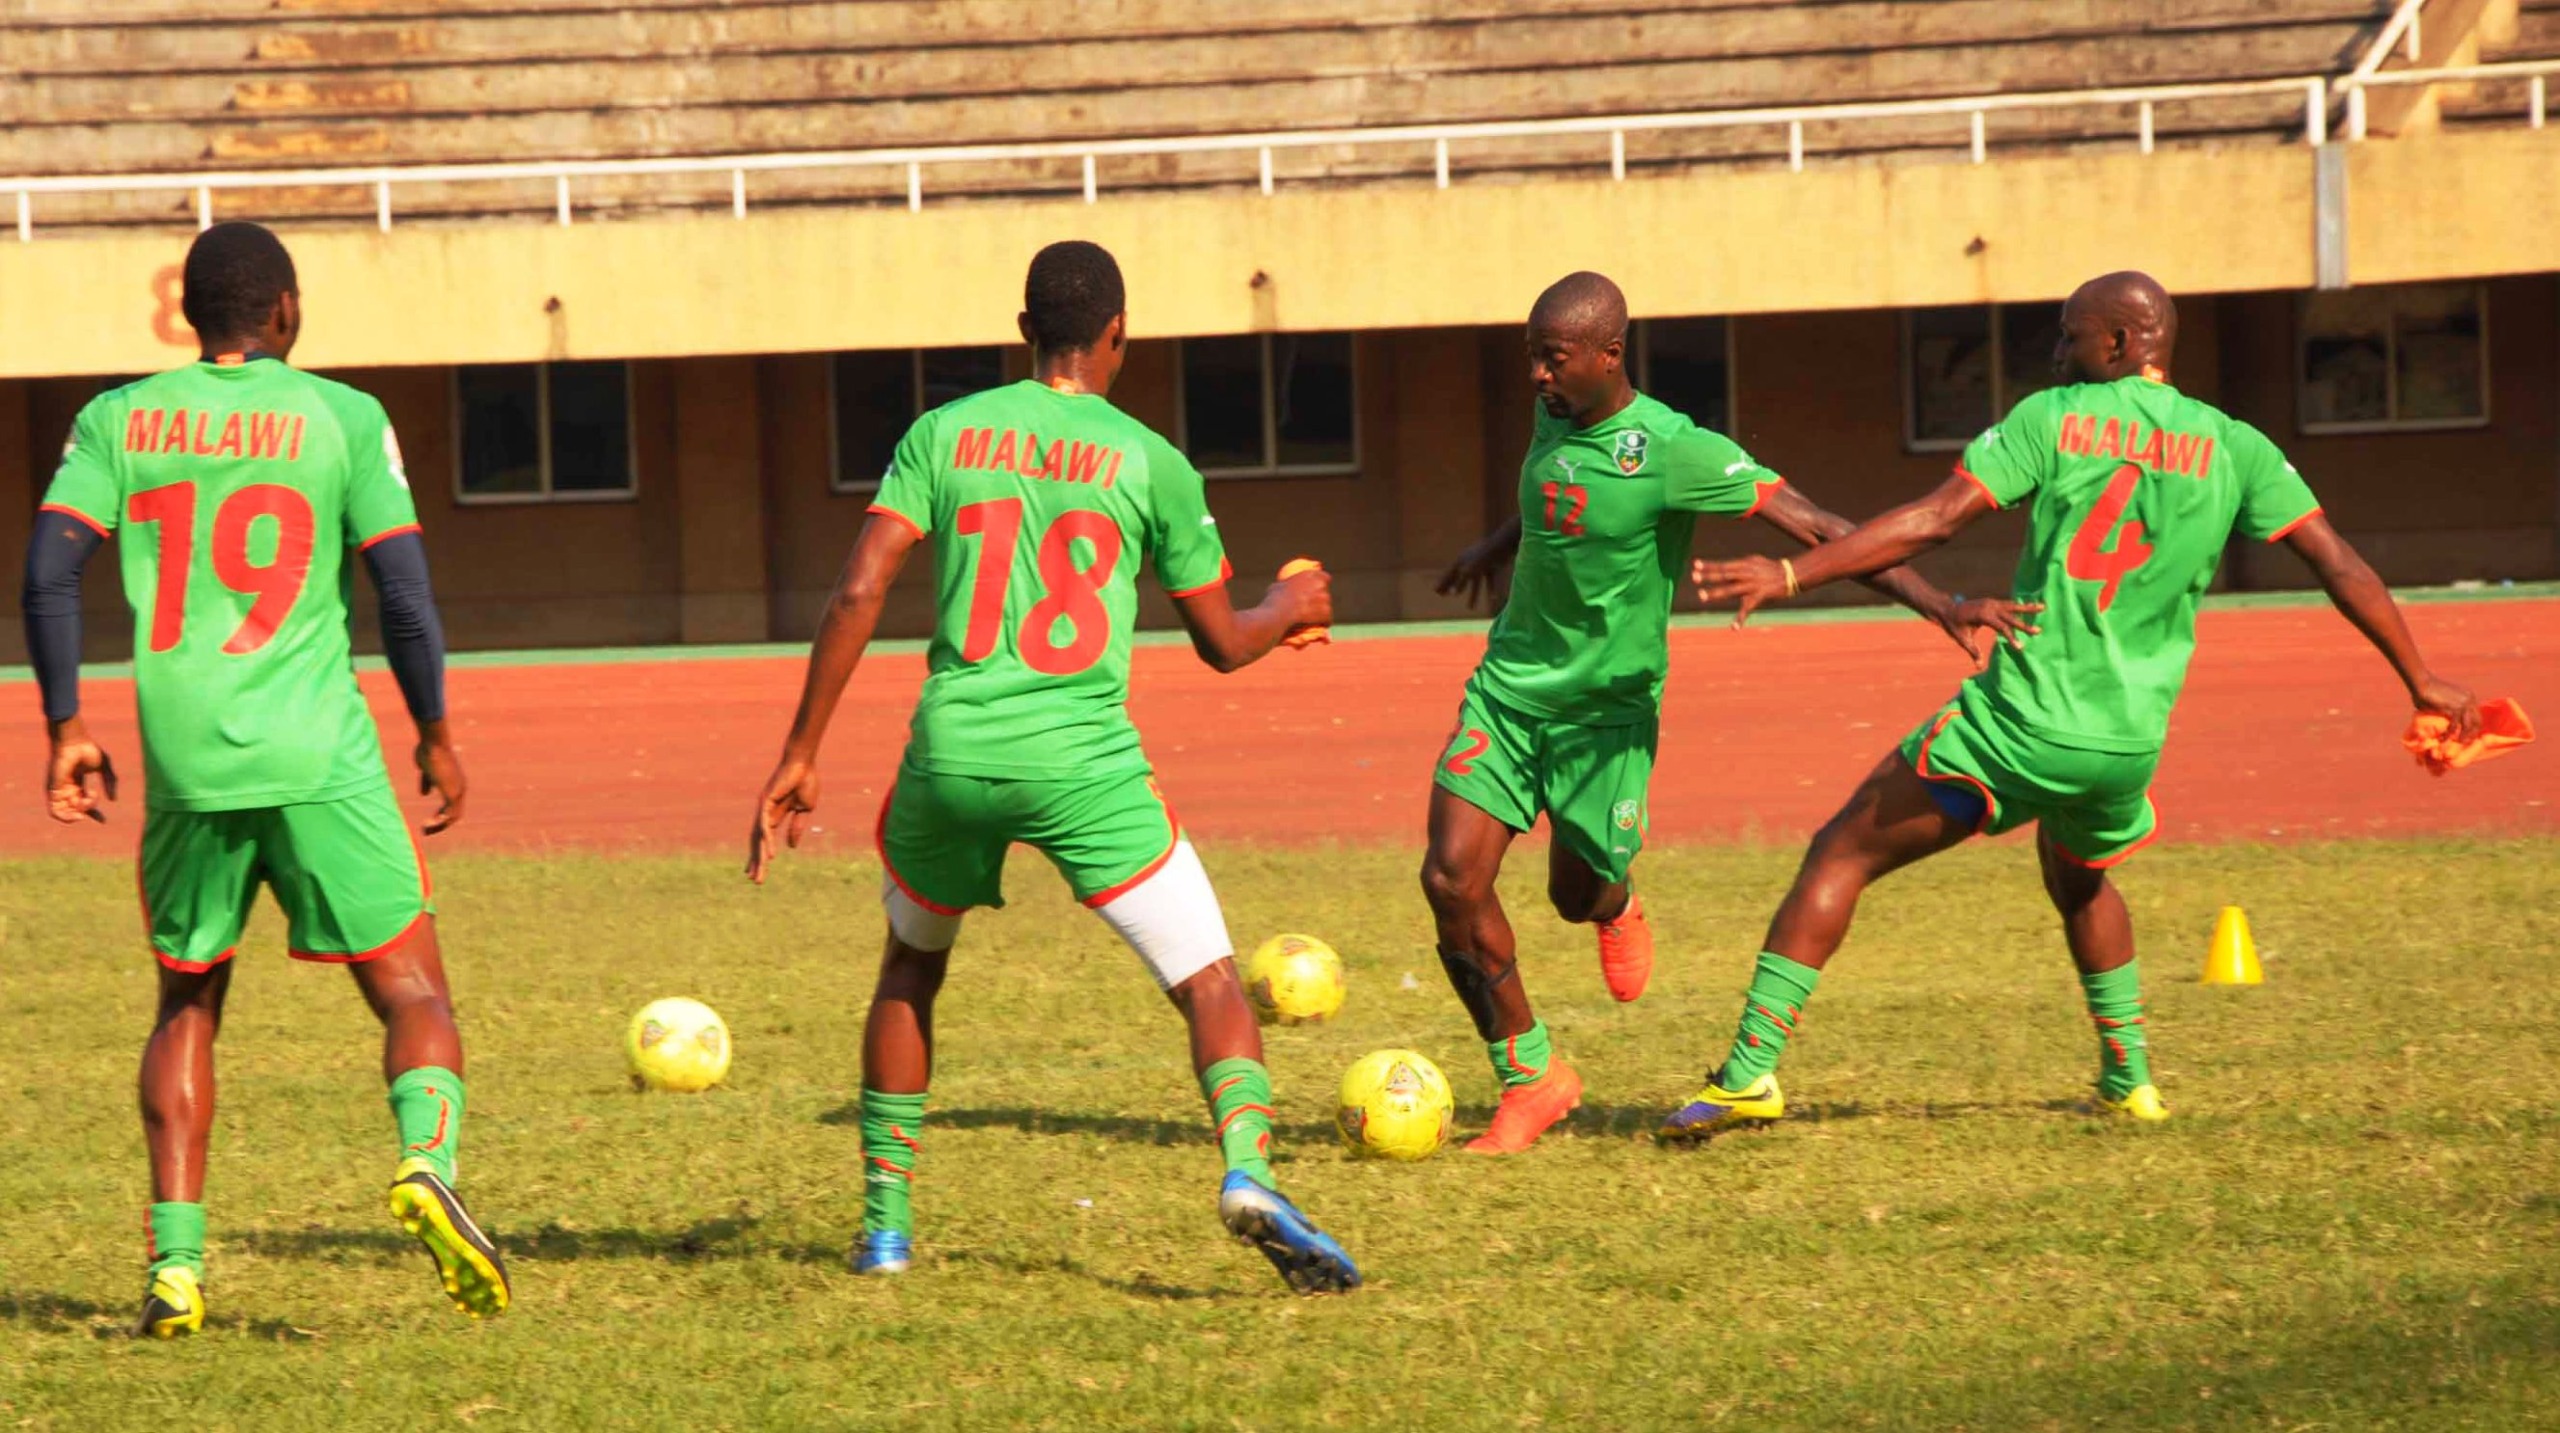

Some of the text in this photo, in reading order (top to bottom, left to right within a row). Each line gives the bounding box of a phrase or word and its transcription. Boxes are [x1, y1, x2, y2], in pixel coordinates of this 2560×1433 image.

[125, 408, 305, 461] MALAWI
[953, 427, 1123, 490] MALAWI
[2057, 412, 2215, 480] MALAWI
[1540, 480, 1590, 537] 12
[2064, 462, 2155, 614] 4
[127, 480, 316, 655] 19
[956, 496, 1123, 676] 18
